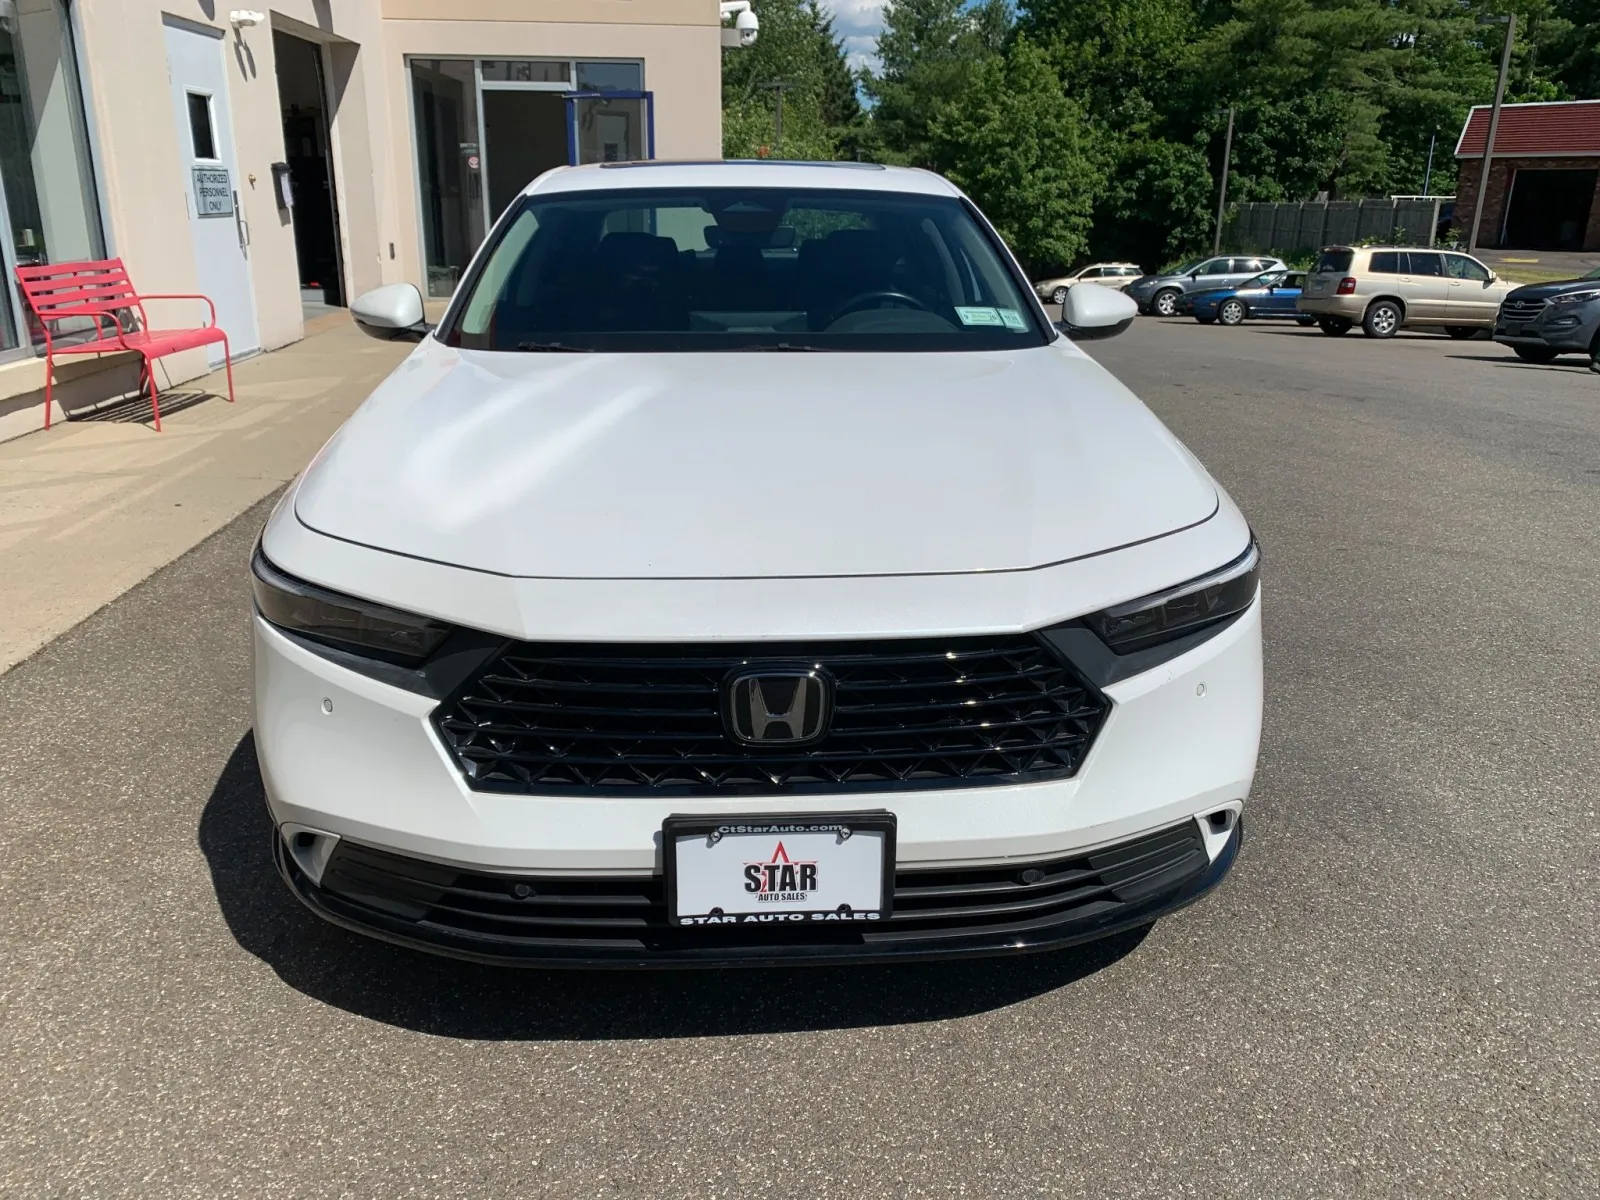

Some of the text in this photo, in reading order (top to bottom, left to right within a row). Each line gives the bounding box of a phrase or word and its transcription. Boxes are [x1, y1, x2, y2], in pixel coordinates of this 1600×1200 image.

[196, 173, 228, 184] AUTHORIZED
[199, 187, 229, 197] PERSONNEL
[208, 201, 222, 211] ONLY
[718, 824, 844, 834] CtStarAuto.com
[744, 863, 817, 893] STAR
[758, 891, 806, 902] AUTO SALES
[680, 912, 881, 925] STAR AUTO SALES
